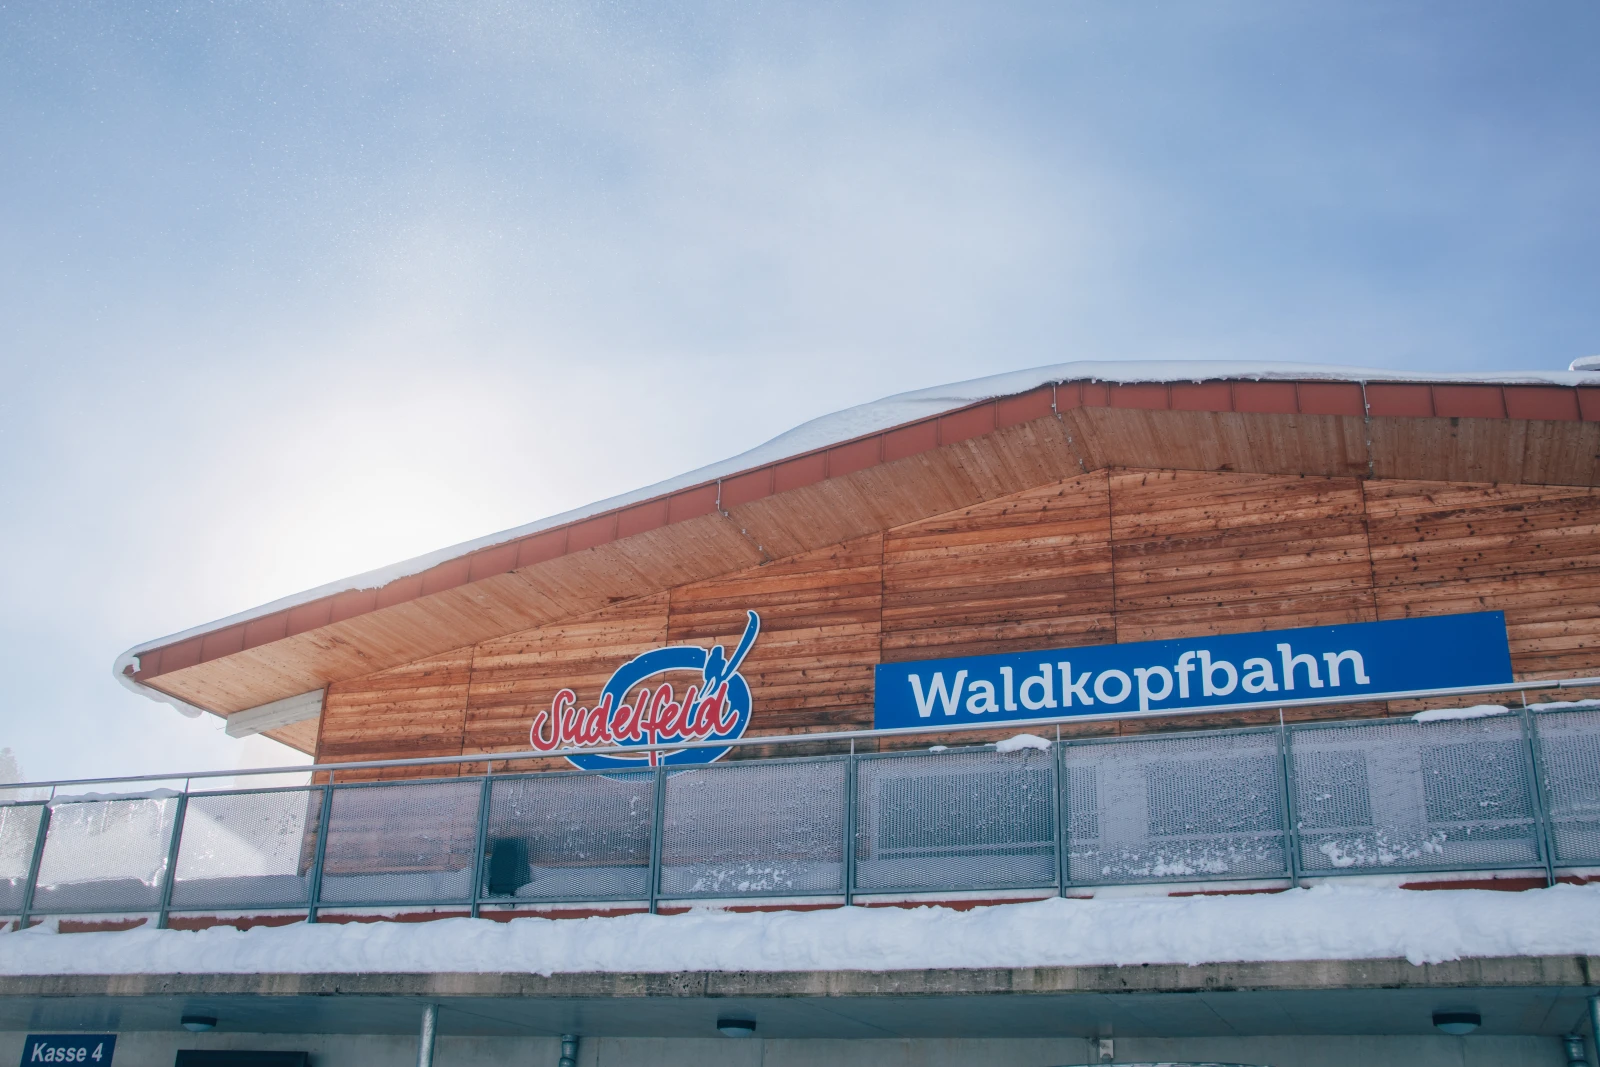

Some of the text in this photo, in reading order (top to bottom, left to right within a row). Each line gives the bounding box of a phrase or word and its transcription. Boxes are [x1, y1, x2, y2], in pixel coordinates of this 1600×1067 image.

[908, 643, 1370, 718] Waldkopfbahn
[530, 682, 740, 766] Sudelfeld
[31, 1043, 103, 1062] Kasse 4
